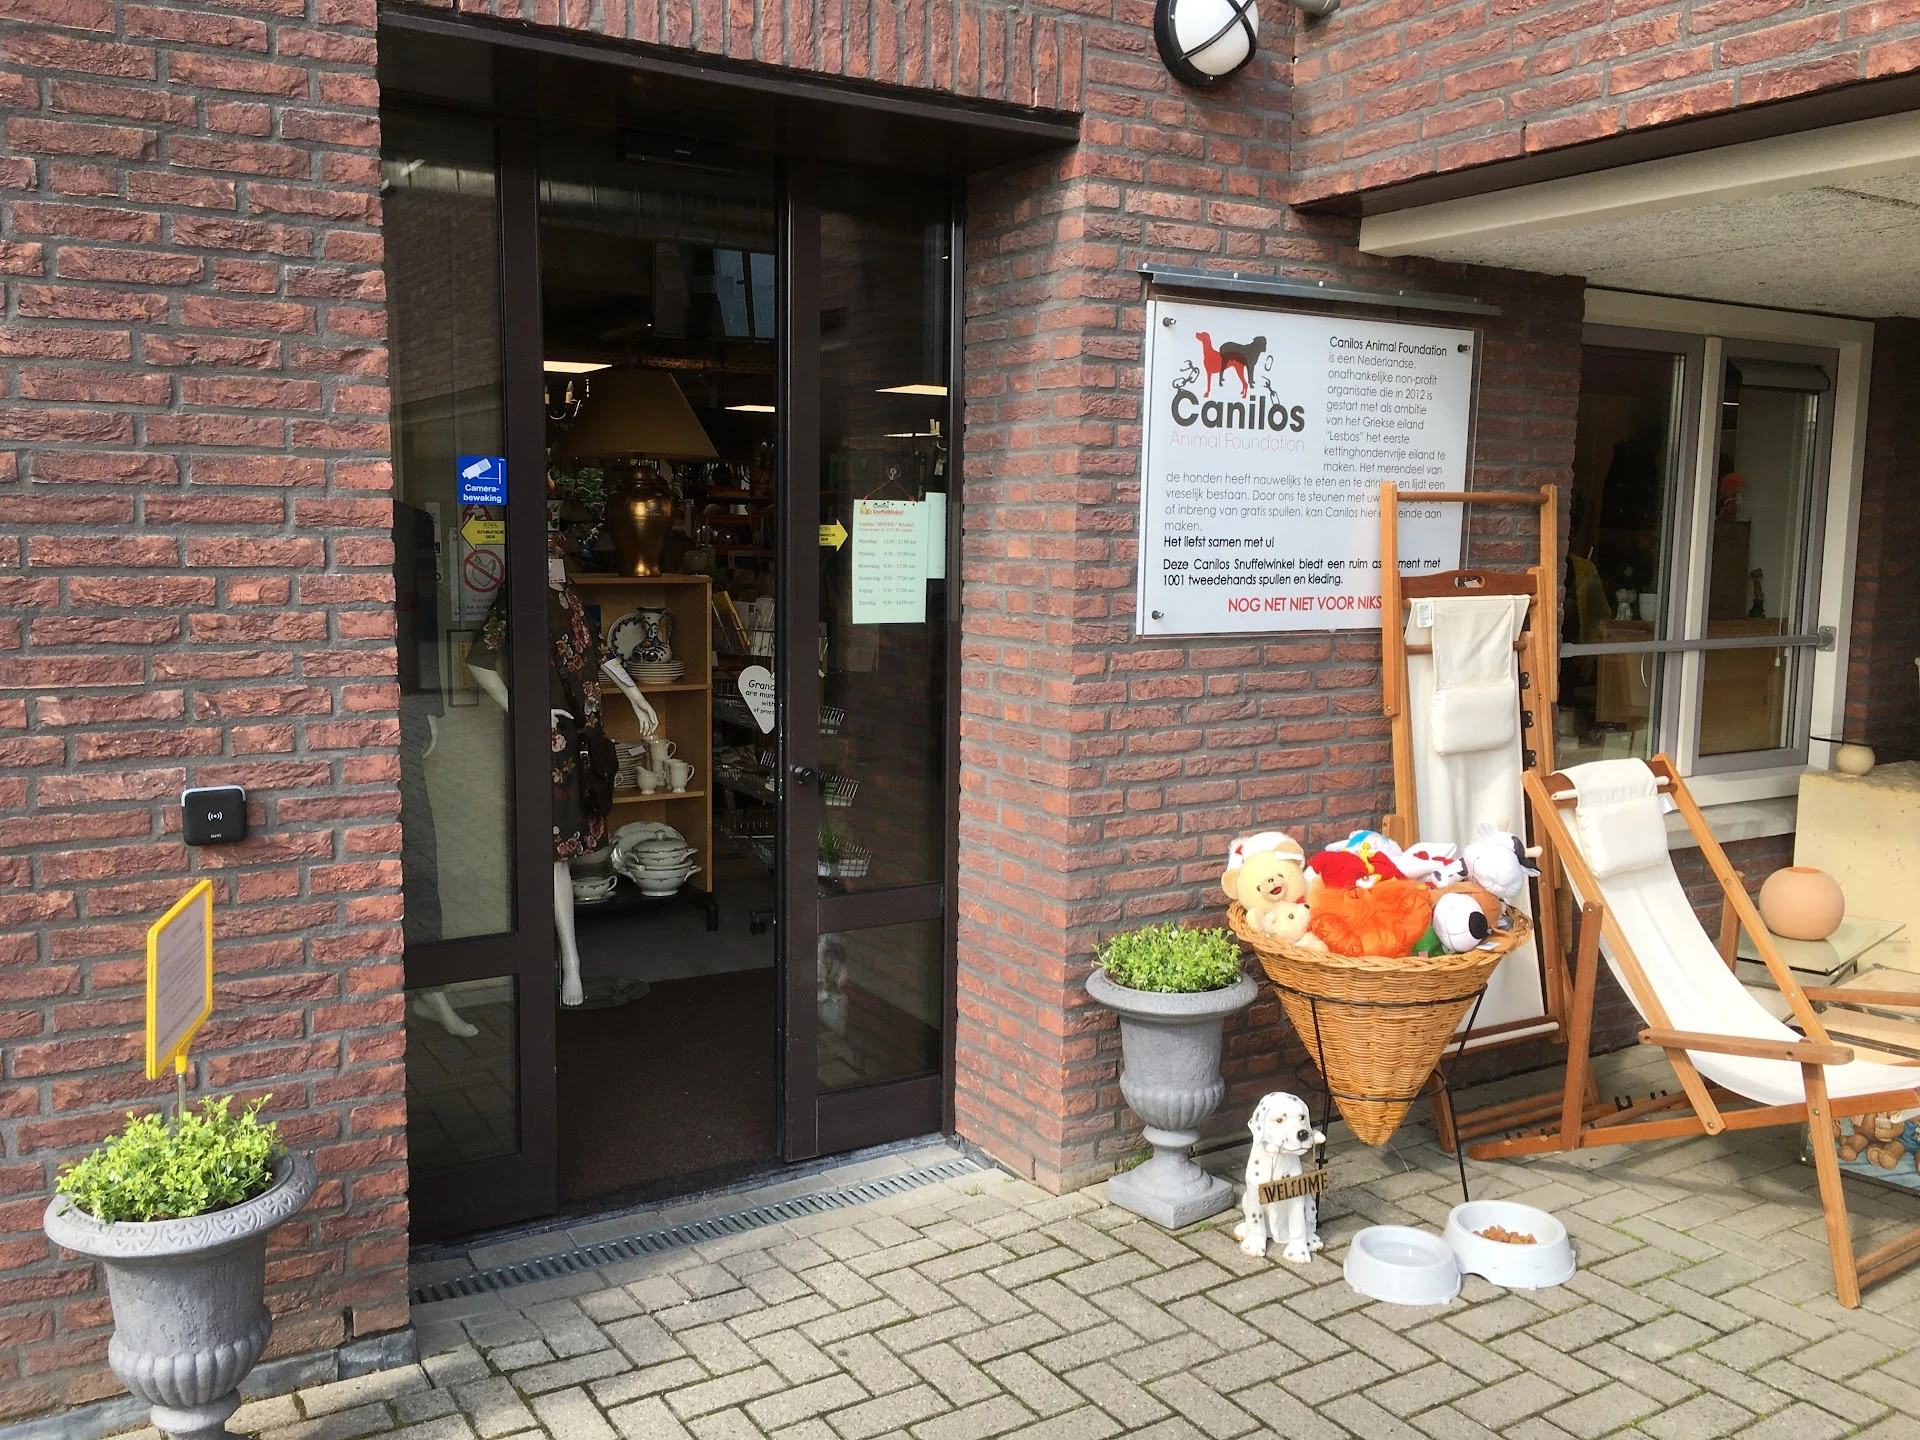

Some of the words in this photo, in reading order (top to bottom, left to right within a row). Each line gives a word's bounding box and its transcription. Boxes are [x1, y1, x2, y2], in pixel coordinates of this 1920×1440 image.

[1330, 337, 1363, 349] Canilos
[1365, 340, 1396, 352] Animal
[1399, 343, 1447, 356] Foundation
[1329, 353, 1335, 362] is
[1337, 355, 1355, 364] een
[1357, 355, 1416, 369] Nederlandse,
[1328, 370, 1394, 384] onafhankelijke
[1396, 374, 1437, 385] non-profit
[1327, 385, 1377, 398] organisatie
[1380, 387, 1393, 397] die
[1396, 388, 1403, 398] in
[1406, 389, 1424, 399] 2012
[1426, 391, 1433, 400] is
[1171, 390, 1304, 432] Canilos
[1327, 400, 1357, 413] gestart
[1361, 401, 1378, 411] met
[1380, 402, 1392, 412] als
[1395, 403, 1426, 414] ambitie
[1326, 417, 1343, 425] van
[1345, 416, 1360, 426] het
[1363, 417, 1395, 428] Griekse
[1397, 419, 1424, 429] eiland
[1170, 431, 1220, 447] Animal
[1225, 433, 1304, 450] Foundation
[1366, 433, 1381, 443] het
[1384, 435, 1409, 443] eerste
[1324, 446, 1407, 460] kettinghondenvrije
[1409, 449, 1435, 459] eiland
[1437, 450, 1445, 460] te
[1324, 462, 1357, 472] maken.
[1360, 462, 1375, 473] Het
[1378, 463, 1424, 473] merendeel
[1426, 465, 1442, 473] van
[464, 484, 500, 492] Camera-
[1167, 472, 1180, 482] de
[1183, 473, 1223, 483] honden
[1226, 474, 1250, 484] heeft
[1254, 475, 1300, 487] nauwelijks
[1303, 476, 1313, 485] te
[1315, 478, 1336, 487] eten
[1339, 479, 1350, 487] en
[1353, 478, 1362, 487] te
[1399, 479, 1410, 488] en
[1412, 479, 1426, 490] lijdt
[1428, 480, 1445, 489] een
[463, 494, 502, 503] bewaking
[1166, 488, 1204, 501] vreselijk
[1206, 489, 1249, 500] bestaan.
[1253, 490, 1276, 501] Door
[1278, 492, 1294, 501] ons
[1297, 492, 1306, 501] te
[1309, 492, 1344, 502] steunen
[1347, 493, 1364, 502] met
[1165, 505, 1176, 515] of
[1178, 505, 1216, 518] inbreng
[1219, 507, 1237, 515] van
[1240, 506, 1266, 518] gratis
[1269, 507, 1303, 519] spullen,
[1306, 508, 1324, 516] kan
[1326, 508, 1358, 517] Canilos
[1361, 508, 1376, 518] hier
[1398, 508, 1422, 518] einde
[1424, 510, 1441, 518] aan
[1164, 520, 1202, 530] maken.
[1164, 536, 1181, 546] Het
[1184, 536, 1205, 546] liefst
[1208, 538, 1241, 546] samen
[1244, 538, 1263, 547] met
[1163, 559, 1188, 569] Deze
[1194, 559, 1230, 569] Canilos
[1234, 559, 1294, 569] Snuffelwinkel
[1299, 559, 1323, 569] biedt
[1327, 560, 1345, 568] een
[1349, 559, 1368, 568] ruim
[1424, 559, 1440, 568] met
[1163, 574, 1184, 585] 1001
[1188, 574, 1256, 586] tweedehands
[1259, 574, 1291, 586] spullen
[1294, 575, 1306, 584] en
[1308, 574, 1343, 585] kleding.
[1228, 598, 1260, 611] NOG
[1264, 597, 1286, 610] NET
[1290, 597, 1314, 610] NIET
[1317, 596, 1354, 609] VOOR
[1263, 1172, 1328, 1203] WELCOME
